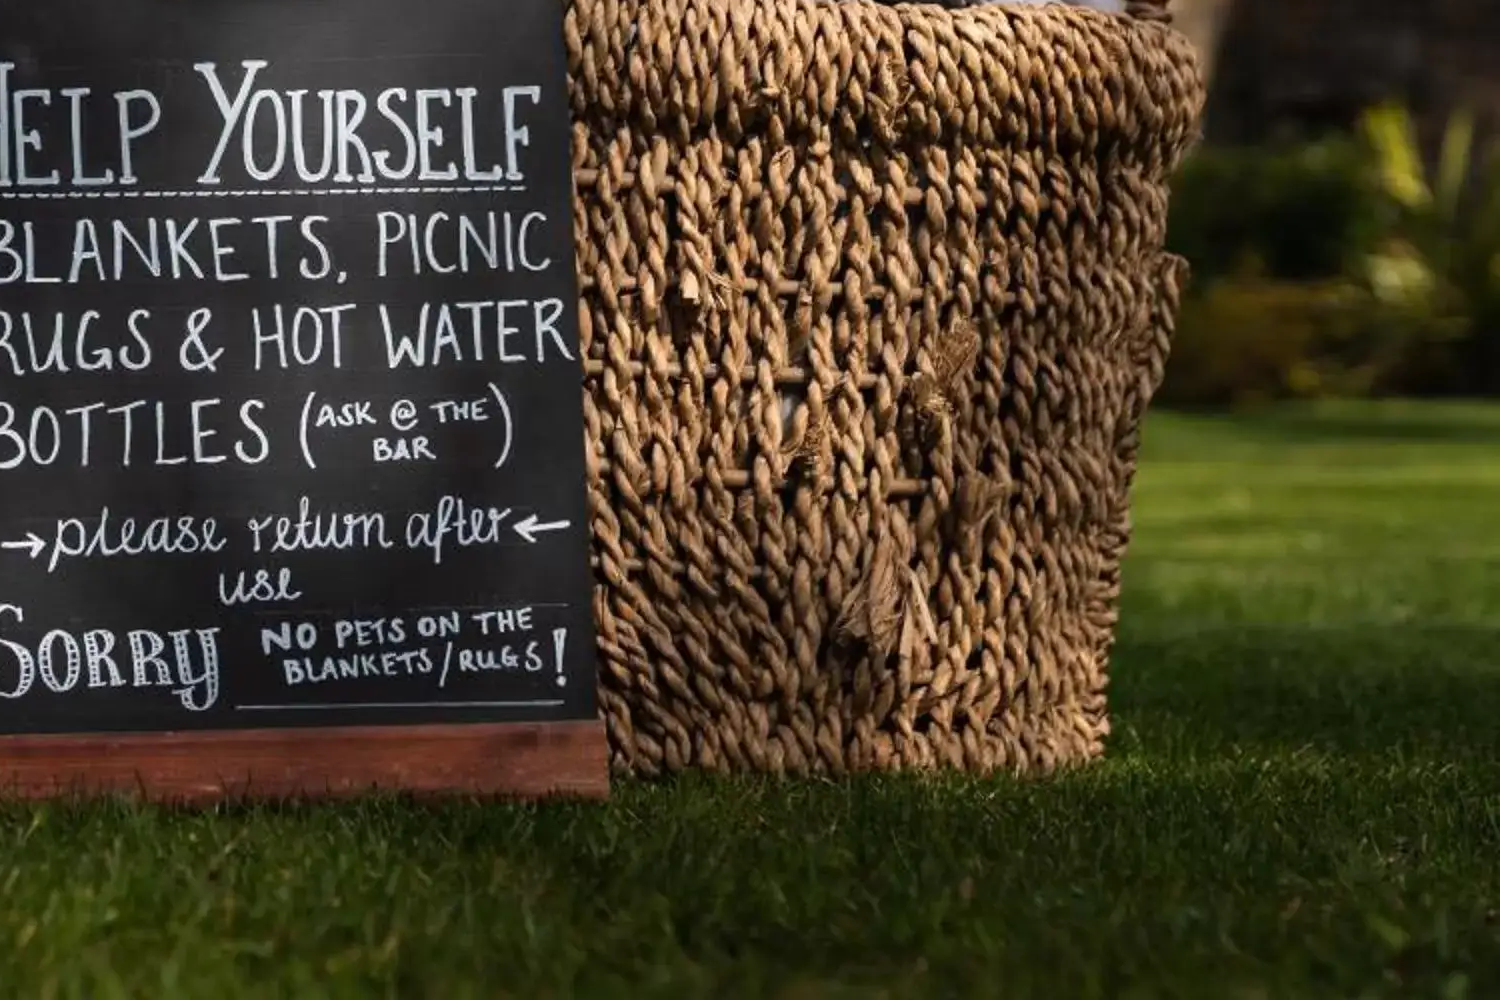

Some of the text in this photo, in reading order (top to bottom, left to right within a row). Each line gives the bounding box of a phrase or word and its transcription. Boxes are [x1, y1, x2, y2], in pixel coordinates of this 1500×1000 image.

[194, 60, 540, 184] YOURSELF
[377, 210, 551, 277] PICNIC
[179, 307, 225, 372] &
[252, 303, 357, 371] HOT
[379, 298, 575, 369] WATER
[390, 399, 419, 432] @
[372, 436, 437, 462] BAR
[48, 495, 512, 573] please return after
[220, 567, 302, 605] use
[262, 606, 533, 655] NO PETS ON THE
